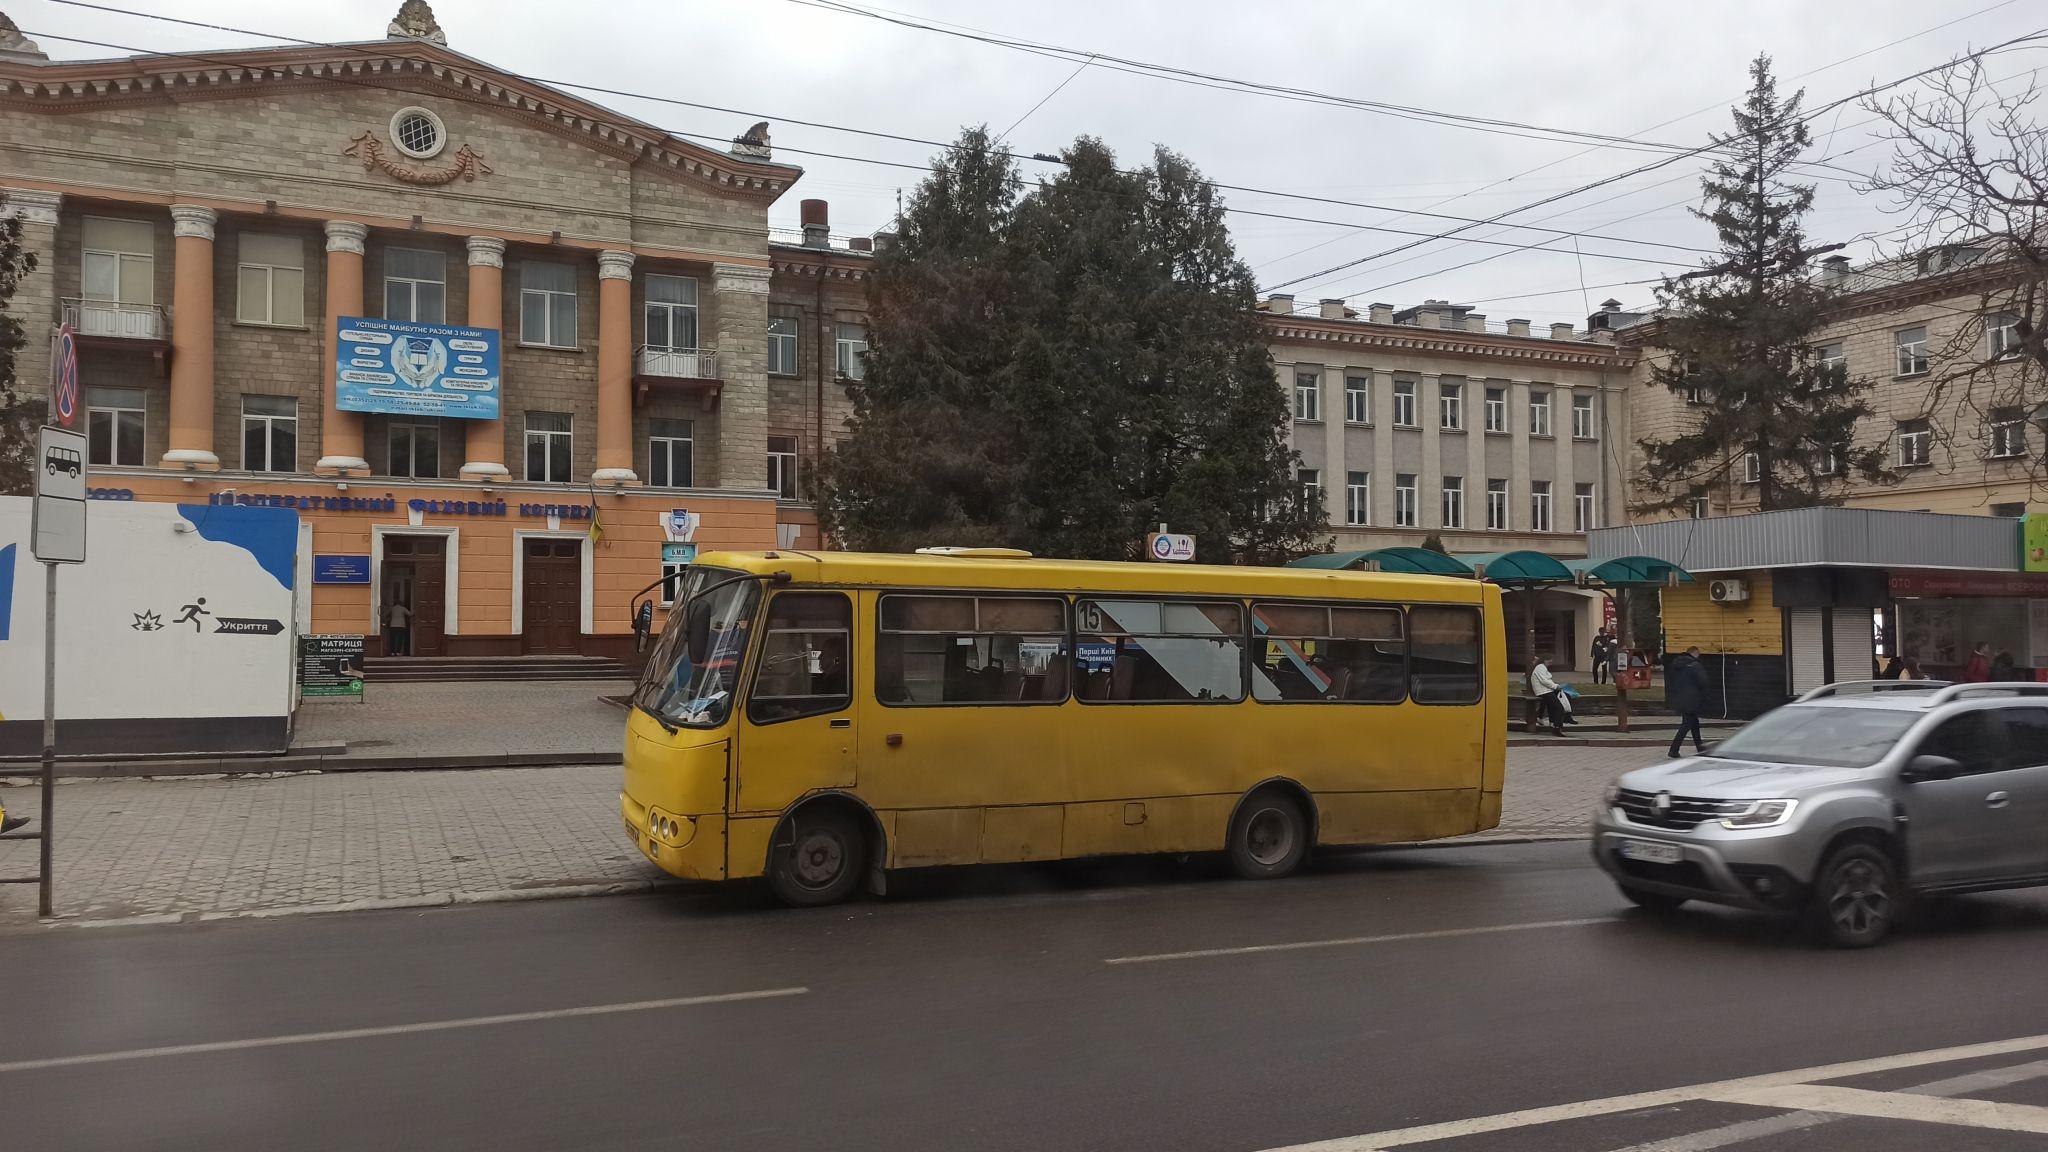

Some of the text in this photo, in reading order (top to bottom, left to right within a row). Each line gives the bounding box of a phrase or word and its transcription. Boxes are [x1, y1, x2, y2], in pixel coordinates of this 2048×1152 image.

[355, 321, 388, 331] УСПІШНЕ
[389, 324, 428, 334] МАЙБУТНЄ
[429, 327, 453, 336] РАЗОМ
[408, 498, 507, 516] ФАХОВИЙ
[1888, 578, 1911, 588] ОТО
[1080, 605, 1099, 630] 15
[222, 621, 268, 632] Укриття
